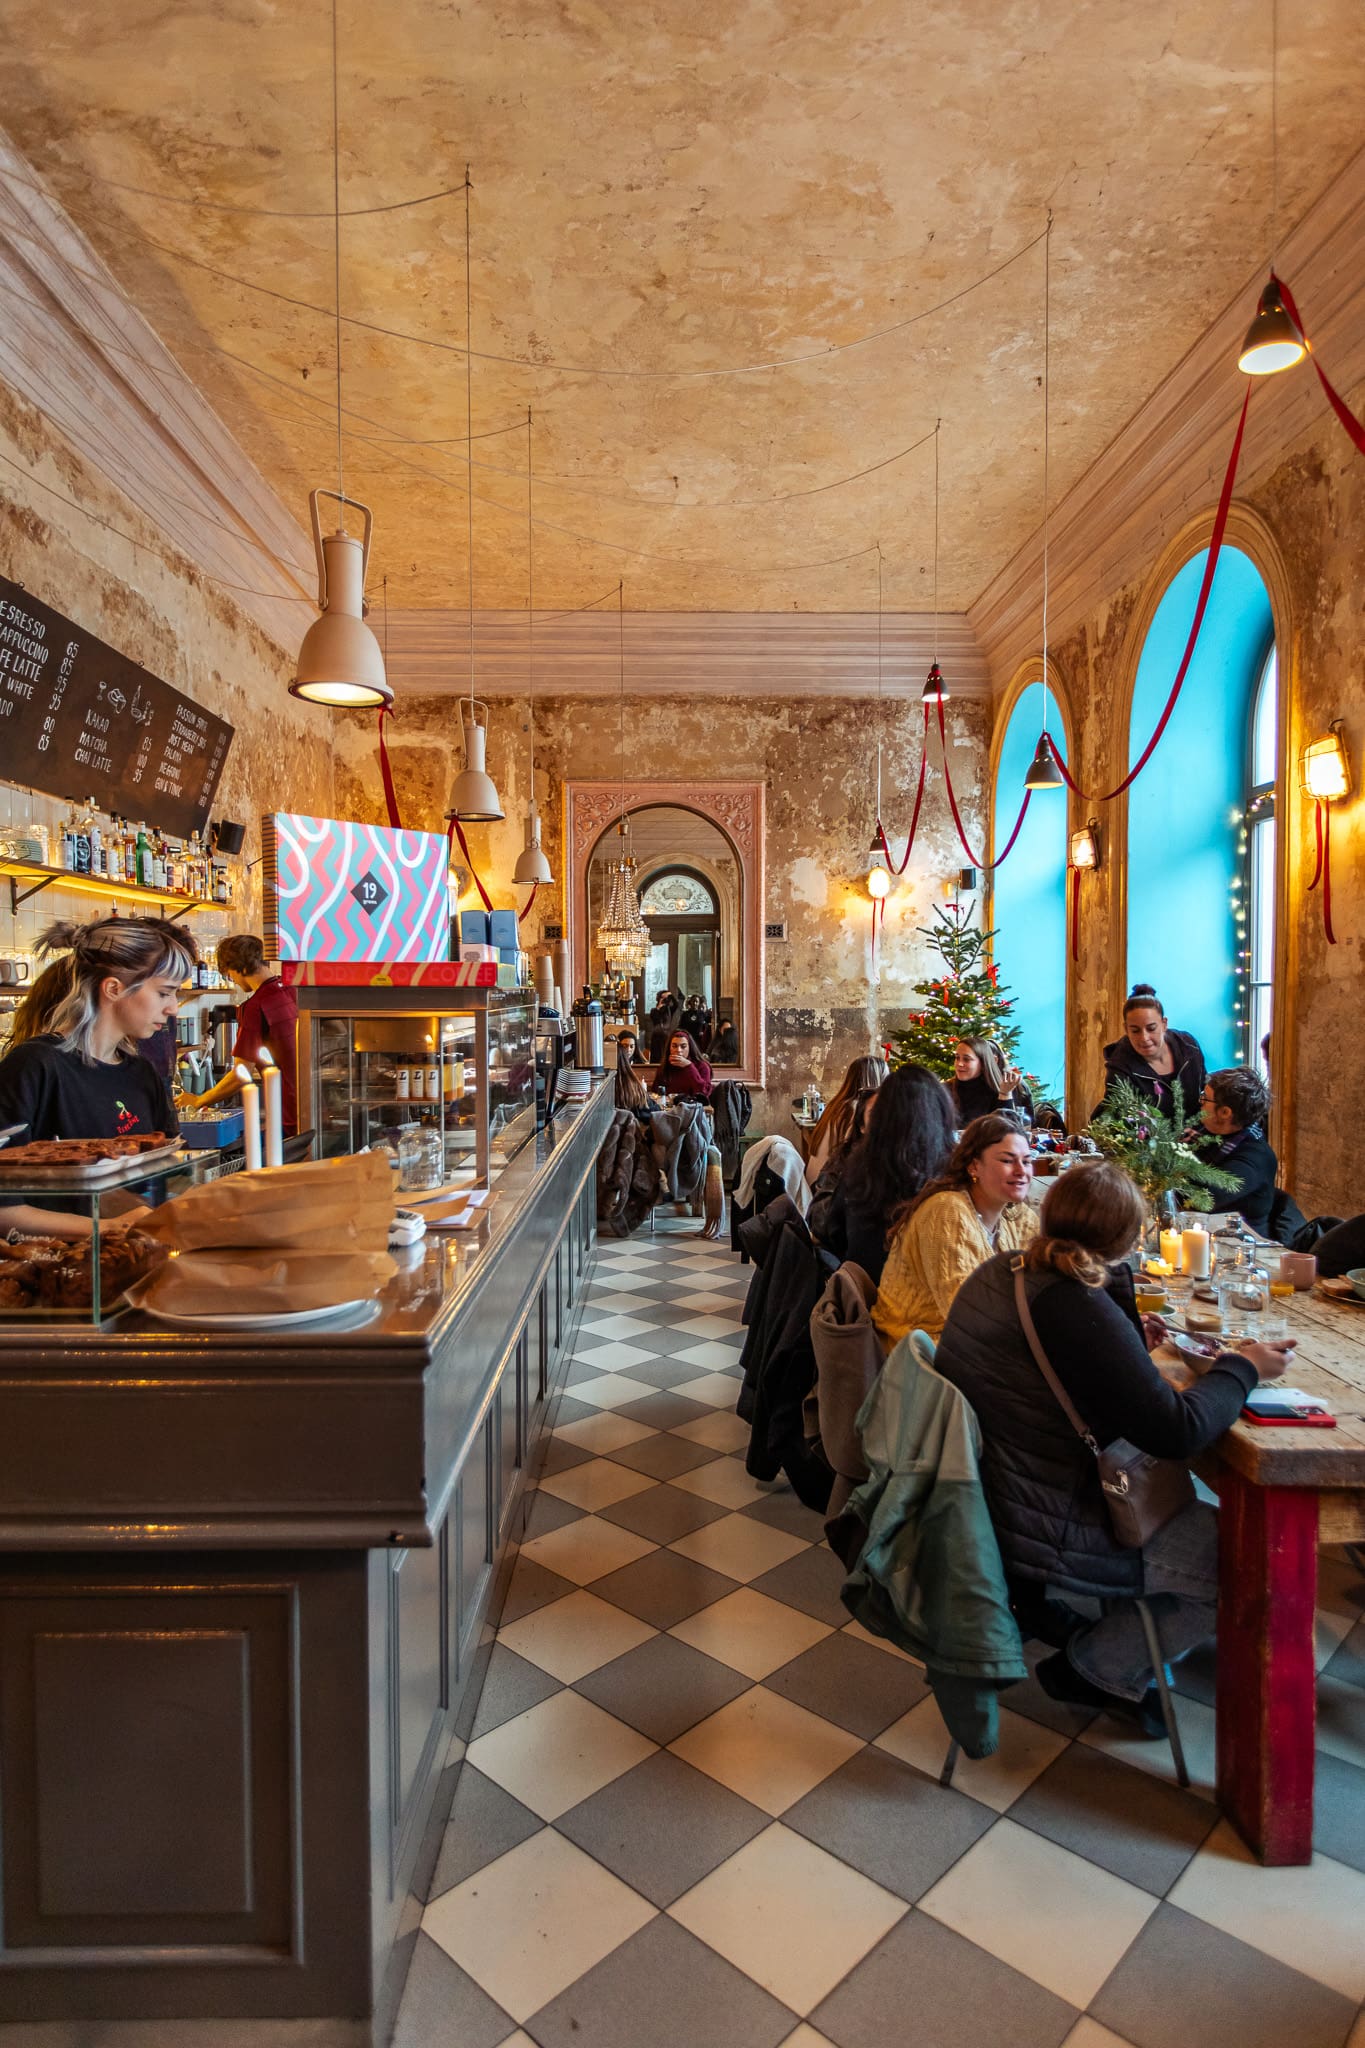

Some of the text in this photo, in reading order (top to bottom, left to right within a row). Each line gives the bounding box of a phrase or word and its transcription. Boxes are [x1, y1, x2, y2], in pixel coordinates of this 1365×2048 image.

[0, 622, 74, 676] APPUCCINO 85
[66, 641, 79, 658] 65
[13, 655, 42, 682] LATTE
[7, 676, 34, 700] WHITE
[0, 698, 14, 717] DO
[91, 755, 112, 773] LATTE
[362, 882, 377, 899] 19
